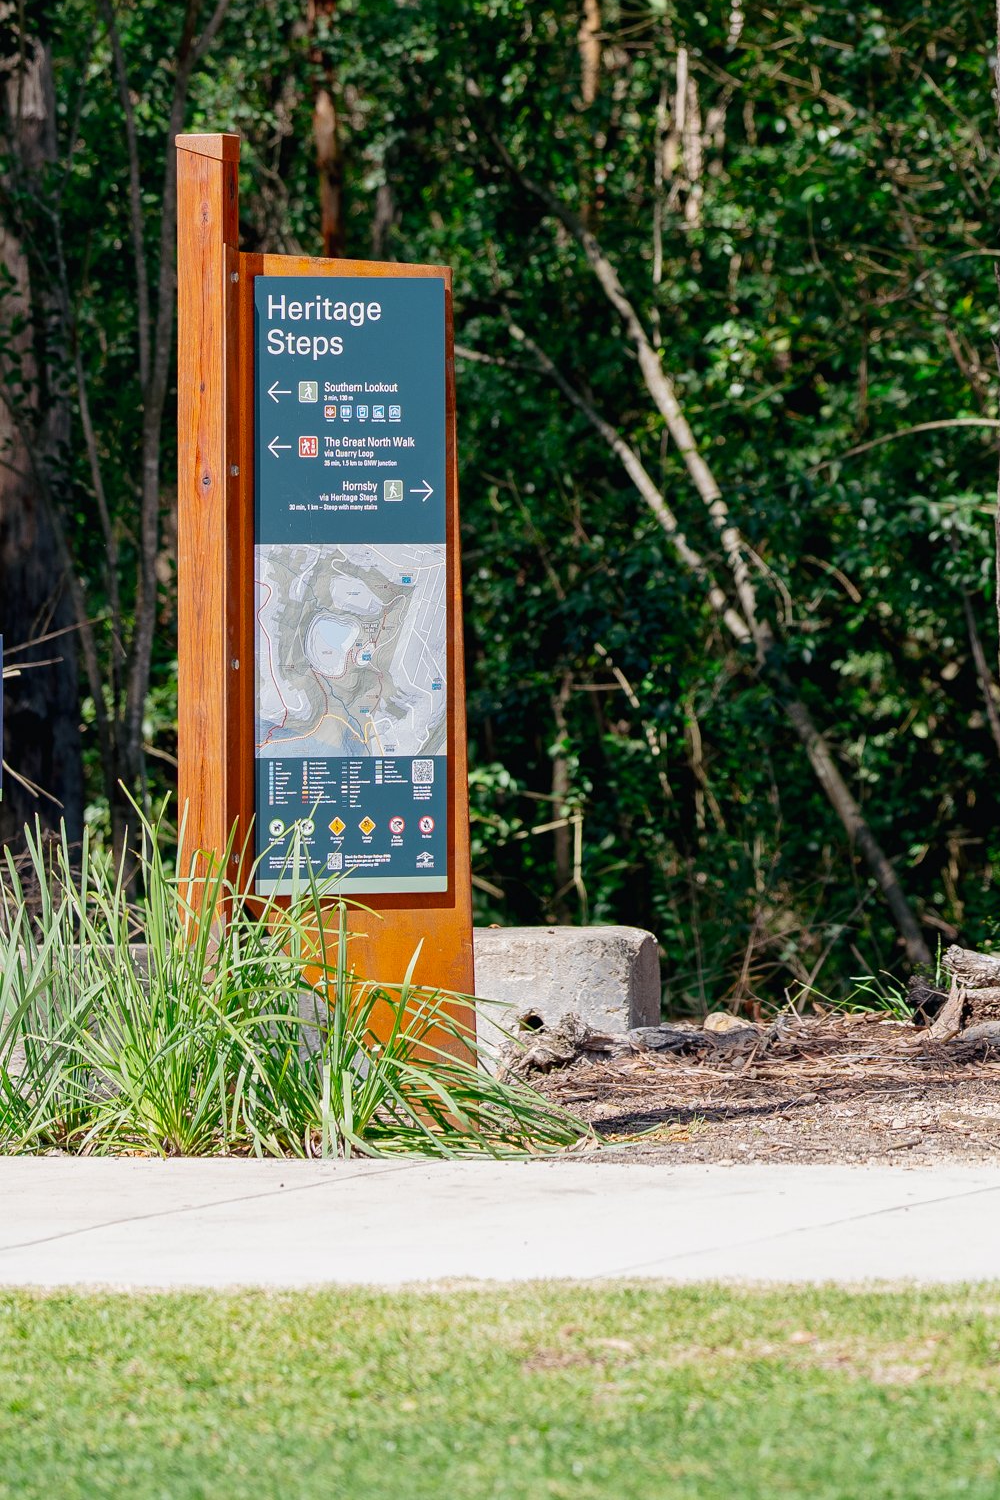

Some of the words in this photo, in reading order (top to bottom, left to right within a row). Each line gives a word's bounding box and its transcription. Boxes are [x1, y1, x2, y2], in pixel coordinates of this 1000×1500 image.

[267, 294, 381, 327] Heritage
[267, 328, 344, 361] Steps
[324, 381, 363, 392] Southern
[364, 382, 398, 392] Lookout
[324, 436, 341, 447] The
[342, 436, 366, 447] Great
[367, 436, 392, 447] North
[392, 436, 415, 447] Walk
[335, 450, 357, 459] Quarry
[358, 450, 374, 459] Loop
[331, 460, 341, 468] min,
[377, 460, 397, 468] junction
[342, 481, 378, 493] Hornsby
[330, 494, 358, 503] Heritage
[359, 494, 378, 503] Steps
